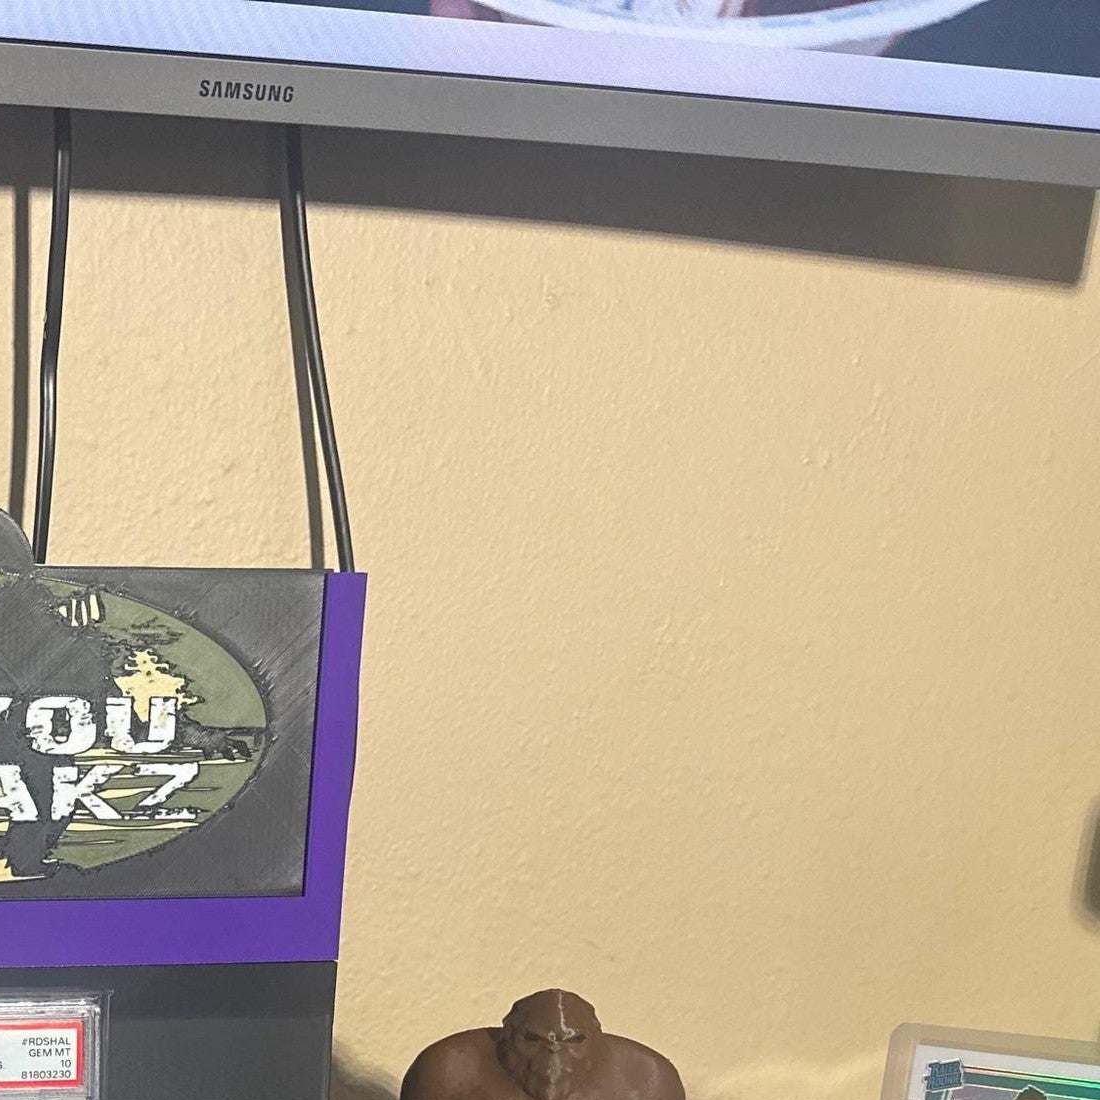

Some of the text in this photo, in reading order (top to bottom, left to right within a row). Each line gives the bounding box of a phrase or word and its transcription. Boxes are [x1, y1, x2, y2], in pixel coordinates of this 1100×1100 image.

[199, 79, 295, 103] SAMSUNG
[21, 1037, 71, 1047] #RDSHAL
[28, 1047, 71, 1058] GEM MT
[60, 1059, 72, 1069] 10
[21, 1070, 71, 1080] 81803230
